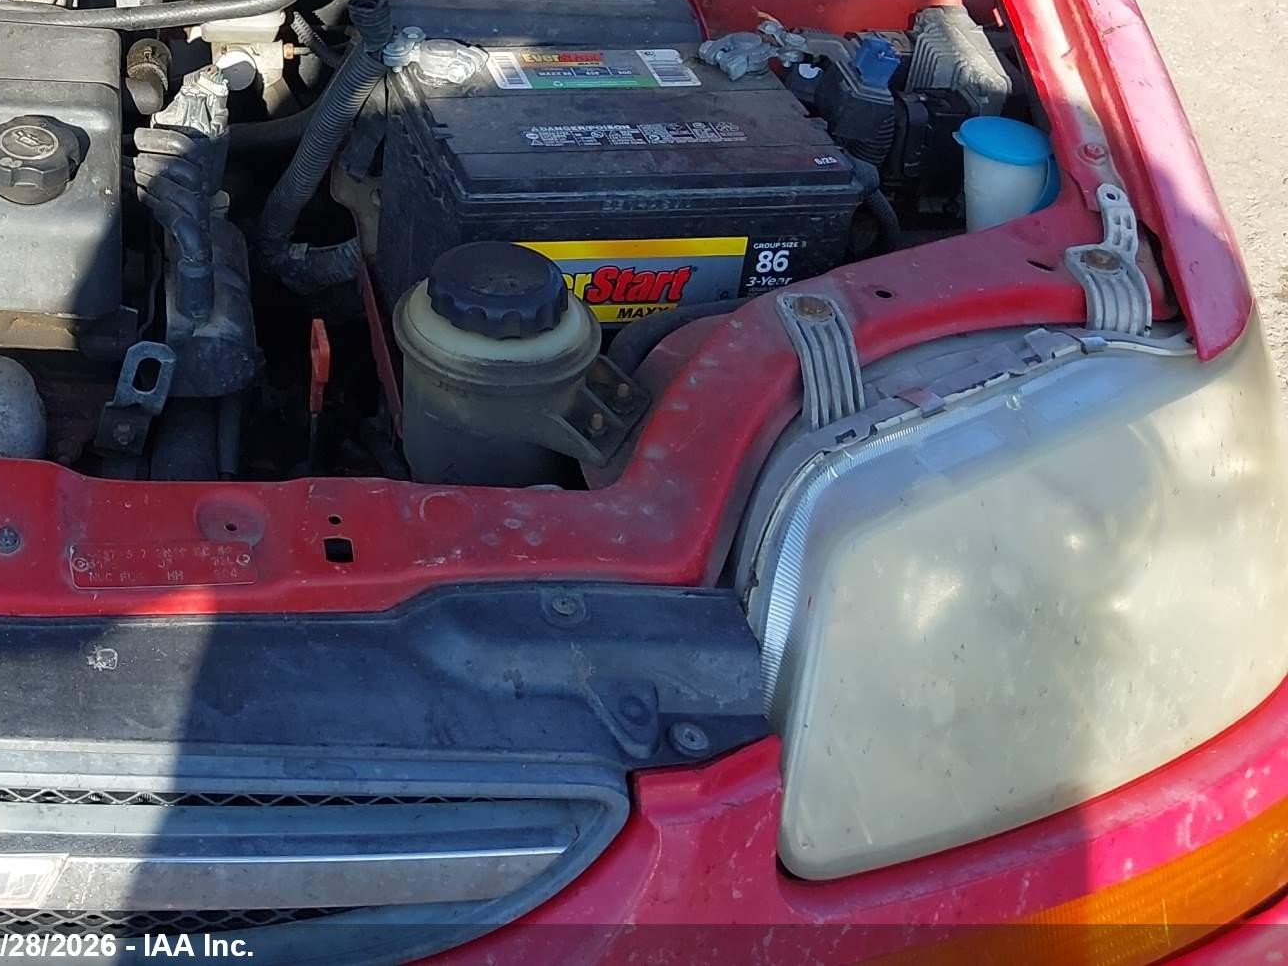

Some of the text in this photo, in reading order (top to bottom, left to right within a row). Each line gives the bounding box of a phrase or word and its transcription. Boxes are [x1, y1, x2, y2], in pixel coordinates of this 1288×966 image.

[753, 242, 781, 250] GROUP
[755, 249, 790, 273] 86
[745, 276, 792, 287] 3-Year
